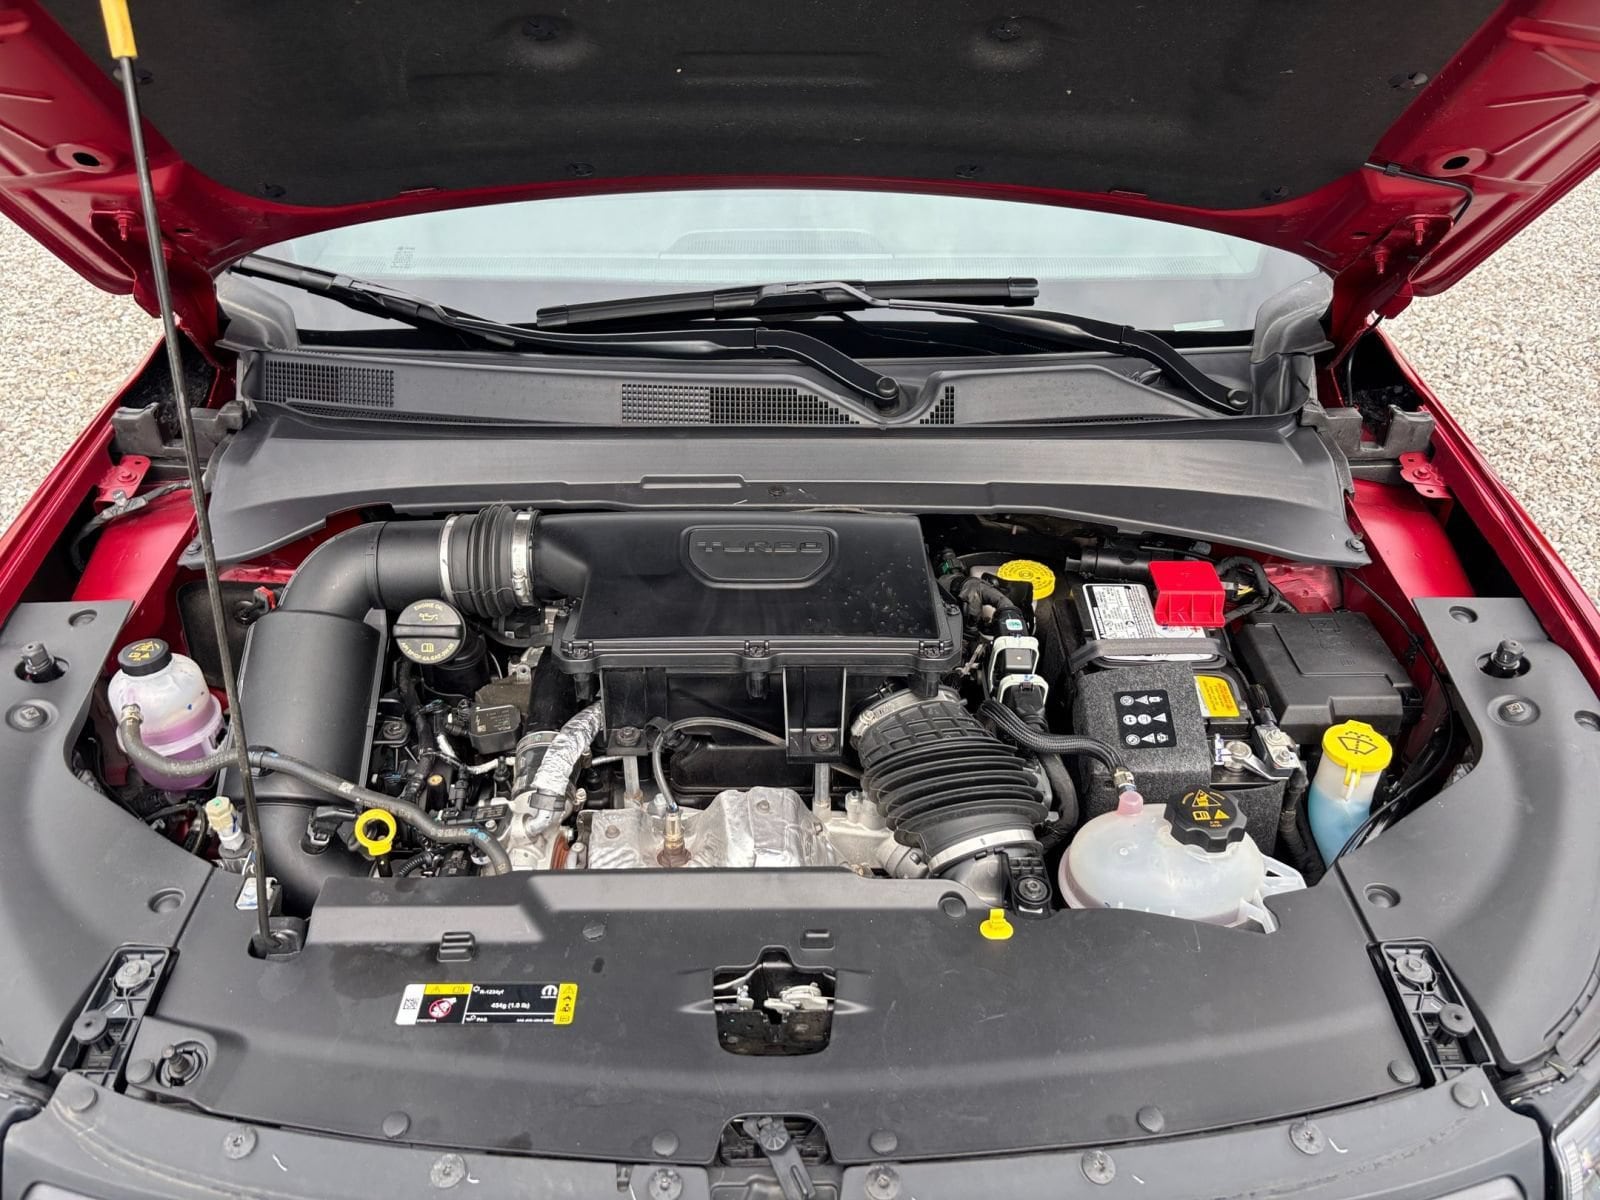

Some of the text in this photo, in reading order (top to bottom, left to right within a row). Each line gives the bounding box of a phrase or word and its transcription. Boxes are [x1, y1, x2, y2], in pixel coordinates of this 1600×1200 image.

[697, 541, 824, 554] TURBO
[413, 602, 444, 612] ENGINE OIL
[490, 1002, 507, 1010] 454g
[520, 1002, 531, 1010] lb)
